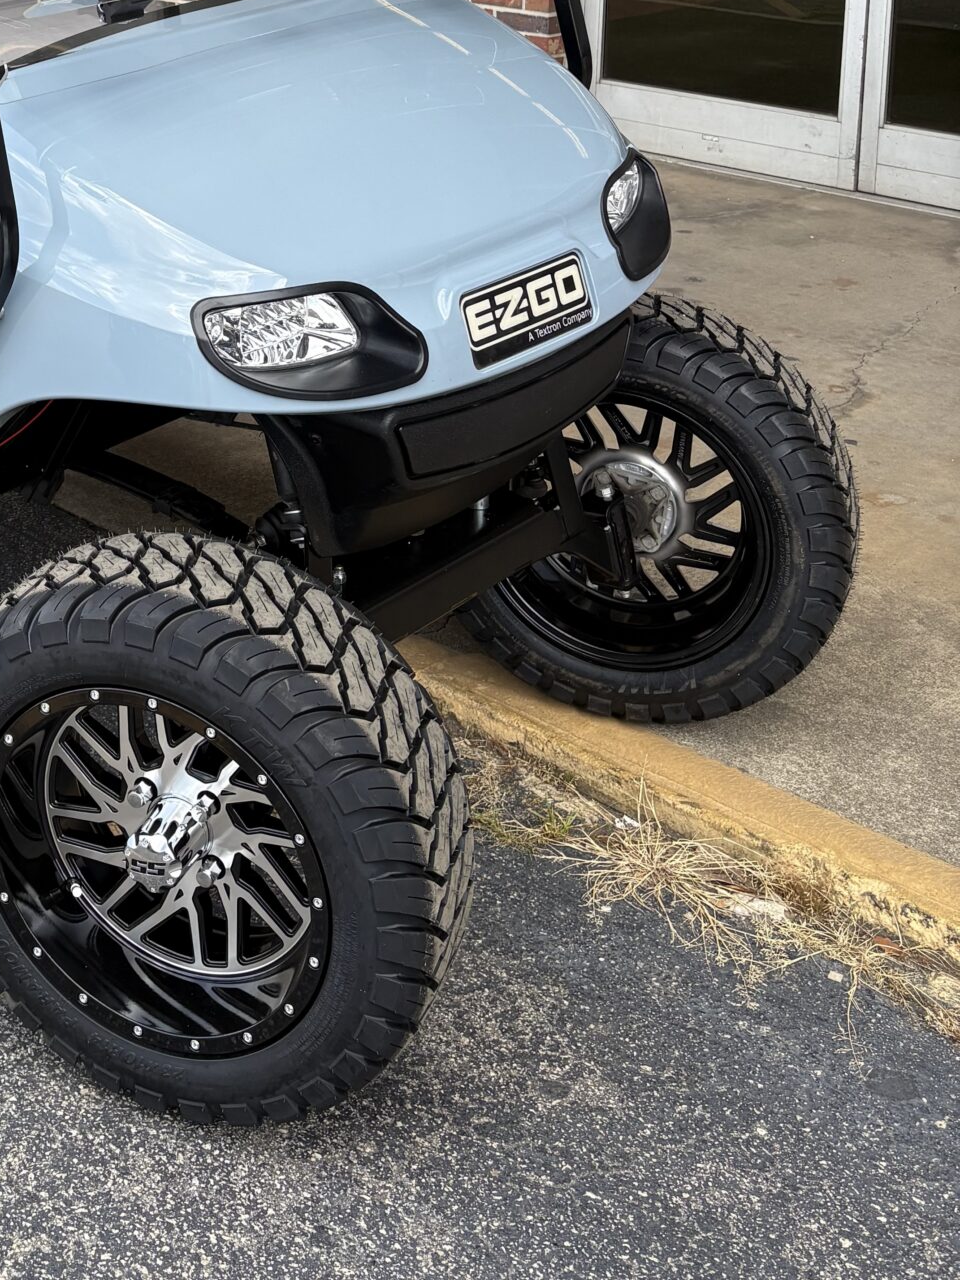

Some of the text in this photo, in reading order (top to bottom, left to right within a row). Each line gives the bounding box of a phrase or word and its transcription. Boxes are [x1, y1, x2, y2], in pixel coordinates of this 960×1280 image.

[528, 309, 593, 342] A Textron Company
